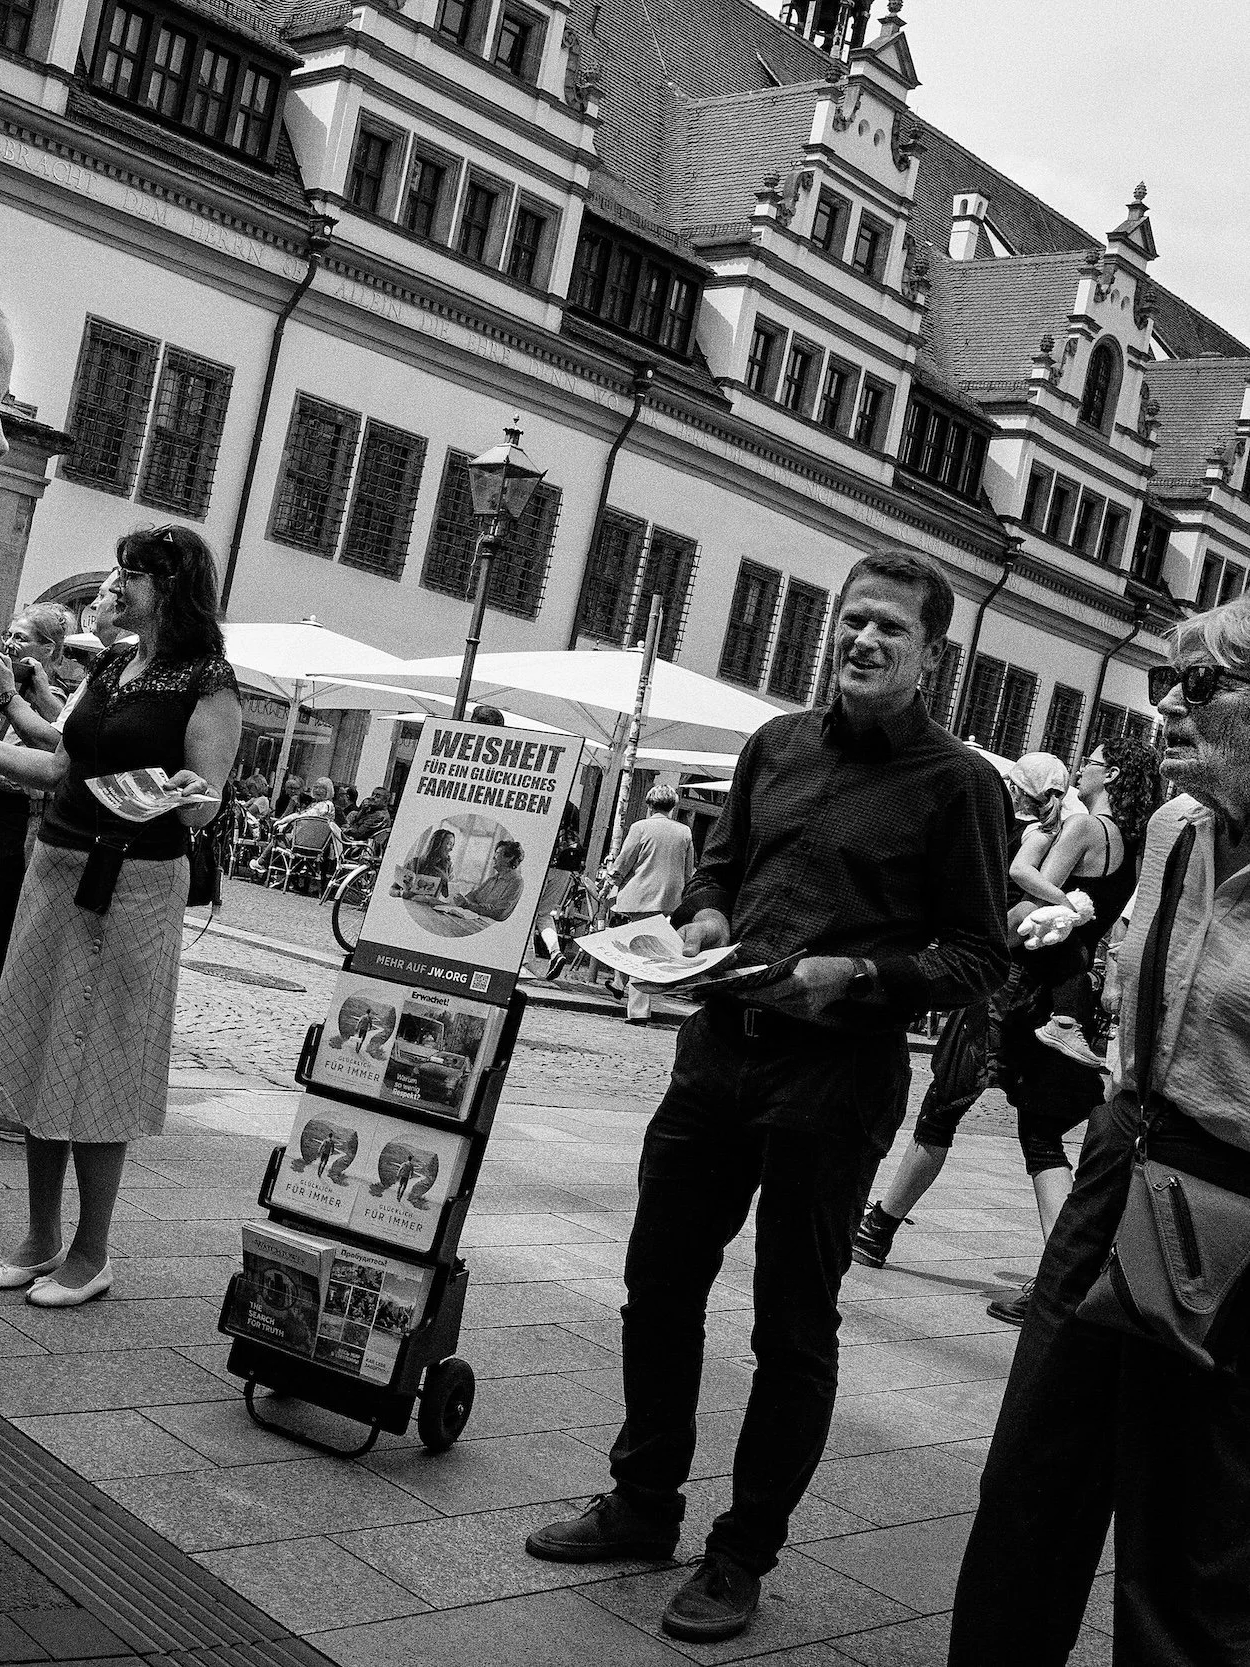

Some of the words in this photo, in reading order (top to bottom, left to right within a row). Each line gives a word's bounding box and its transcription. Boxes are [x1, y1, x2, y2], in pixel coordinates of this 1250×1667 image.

[189, 216, 264, 266] HERRN
[430, 729, 567, 774] WEISHEIT
[422, 758, 448, 776] FÜR
[448, 763, 469, 779] EIN
[470, 766, 557, 793] GLÜCKLICHES
[416, 776, 553, 815] FAMILIENLEBEN
[376, 954, 405, 970] MEHR
[405, 961, 428, 974] AUF
[427, 966, 469, 984] JW.ORG
[411, 990, 450, 1007] Erwachet!
[324, 1060, 345, 1073] FÜR
[347, 1065, 380, 1082] IMMER
[285, 1182, 306, 1197] FÜR
[308, 1190, 342, 1208] IMMER
[364, 1207, 386, 1222] FÜR
[388, 1215, 424, 1233] IMMER
[248, 1309, 276, 1326] SEARCH
[249, 1300, 263, 1313] THE
[247, 1317, 262, 1329] FOR
[261, 1322, 285, 1338] TRUTH
